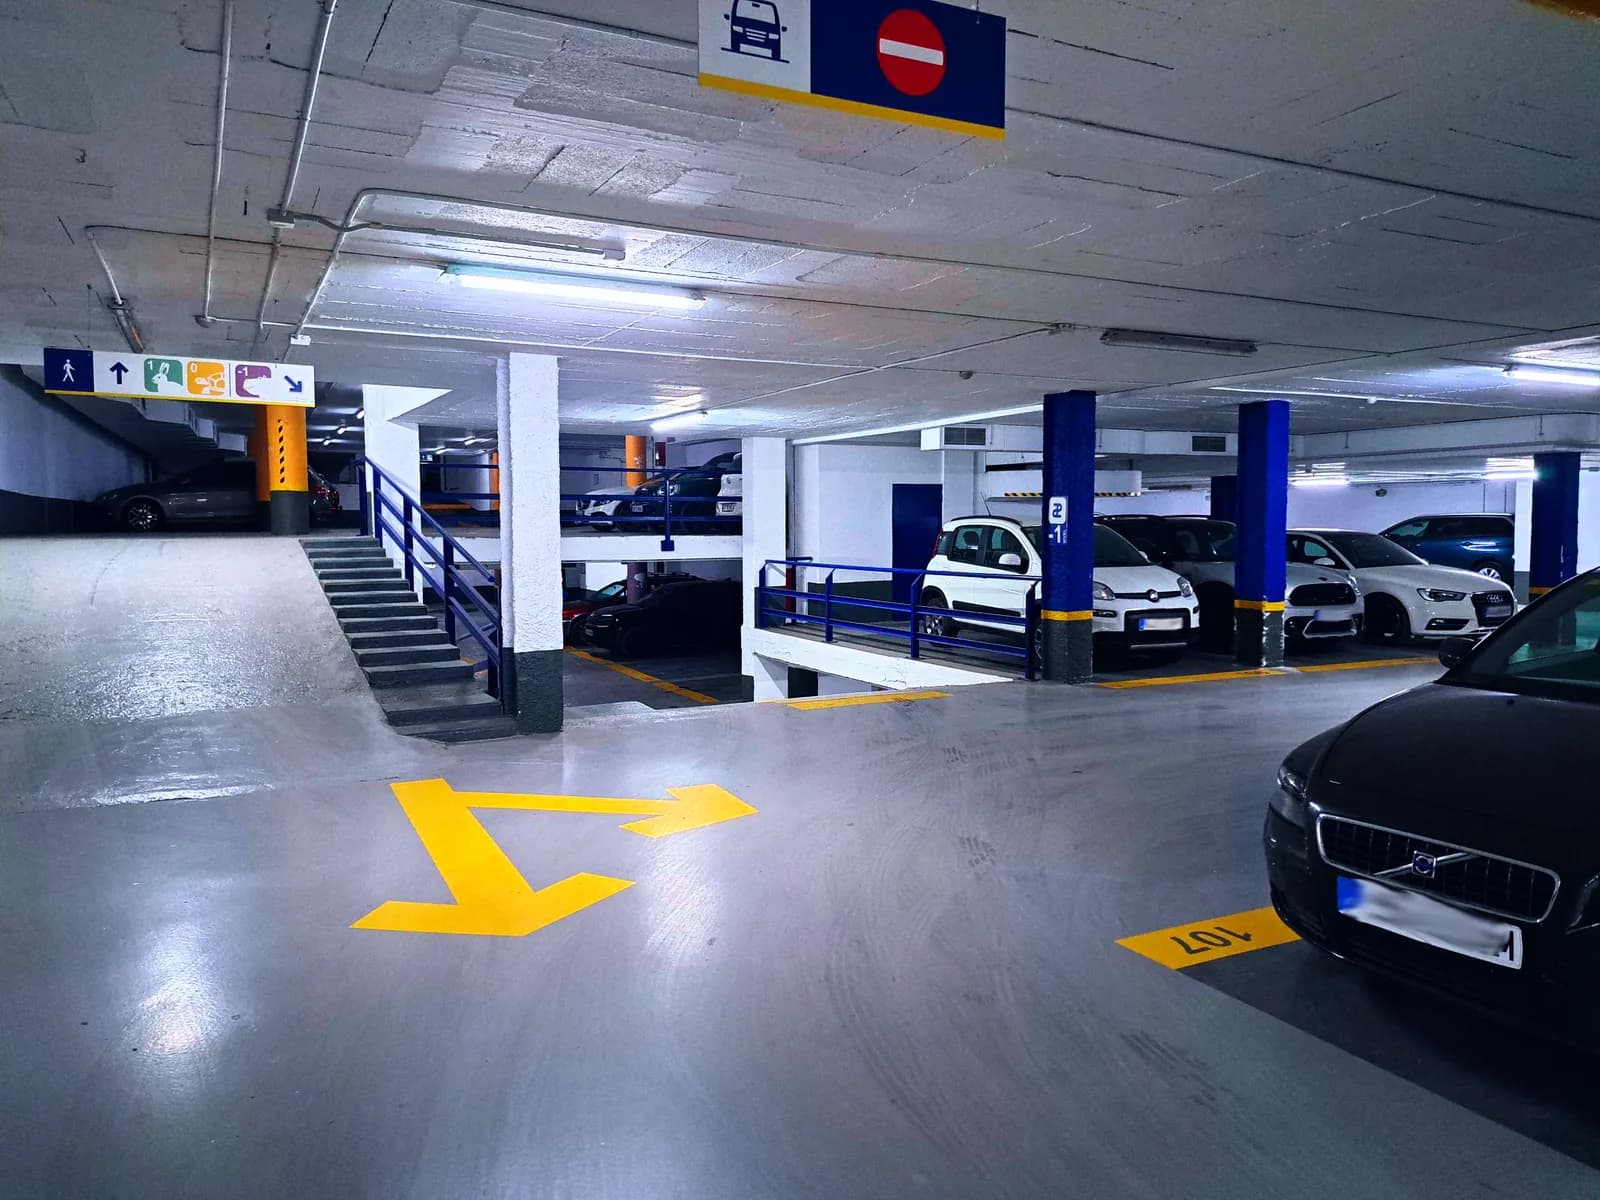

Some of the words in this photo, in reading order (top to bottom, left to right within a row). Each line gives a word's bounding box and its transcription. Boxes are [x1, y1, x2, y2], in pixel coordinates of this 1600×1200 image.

[147, 360, 153, 370] 1
[237, 366, 248, 377] -1
[1170, 926, 1252, 955] 107
